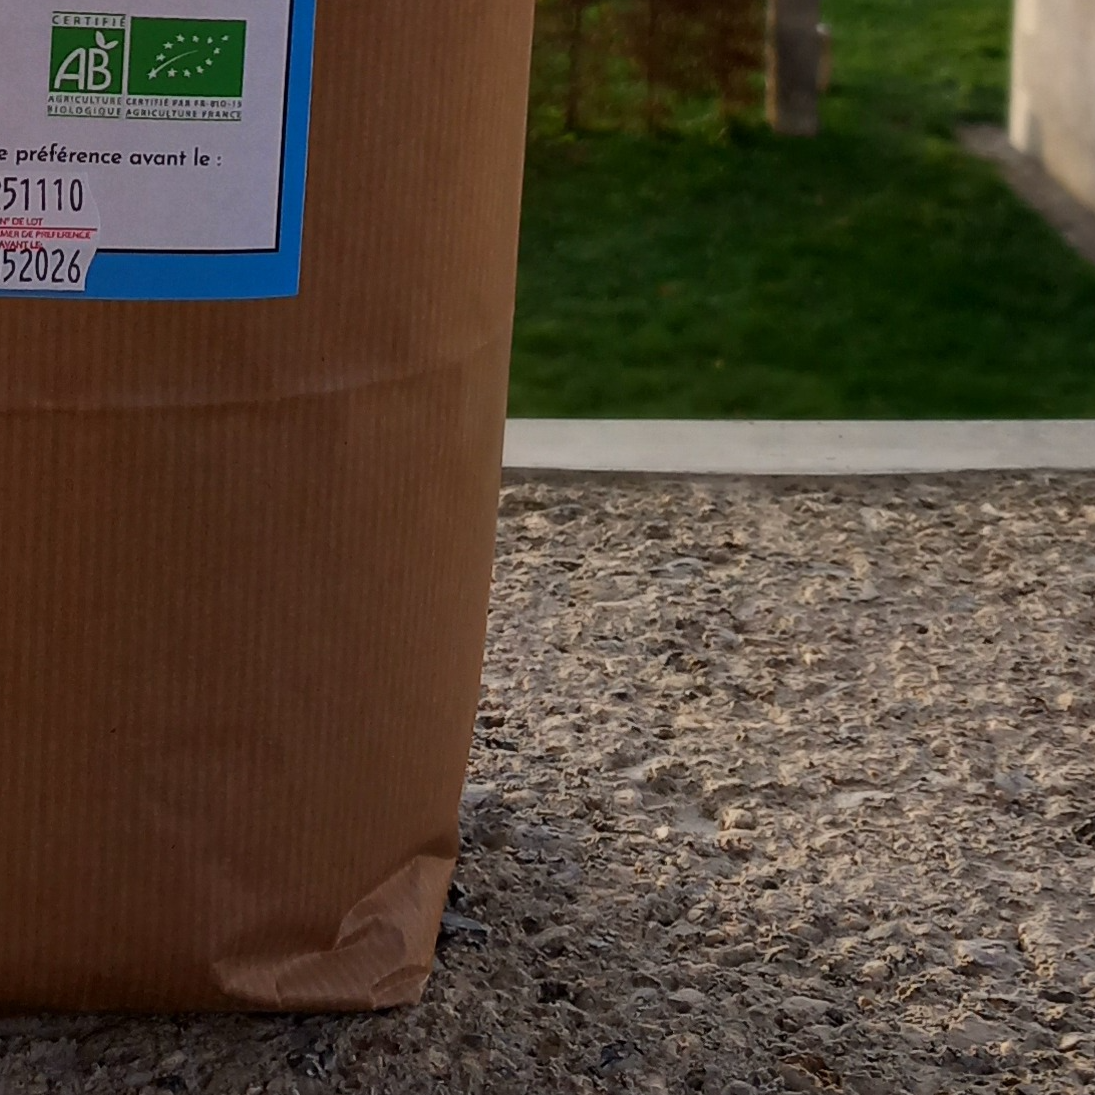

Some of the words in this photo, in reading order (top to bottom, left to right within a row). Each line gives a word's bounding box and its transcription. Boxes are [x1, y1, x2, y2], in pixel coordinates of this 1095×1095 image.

[54, 47, 112, 91] AB
[47, 95, 122, 106] AGRICULTURE
[47, 105, 122, 116] BIOLOGIQUE
[126, 109, 196, 118] AGRICULTURE
[202, 110, 243, 118] FRANCE
[16, 143, 122, 165] préférence
[129, 150, 187, 166] avant
[193, 147, 210, 166] le
[12, 217, 24, 225] DE
[26, 218, 44, 226] LOT
[22, 230, 33, 238] DE
